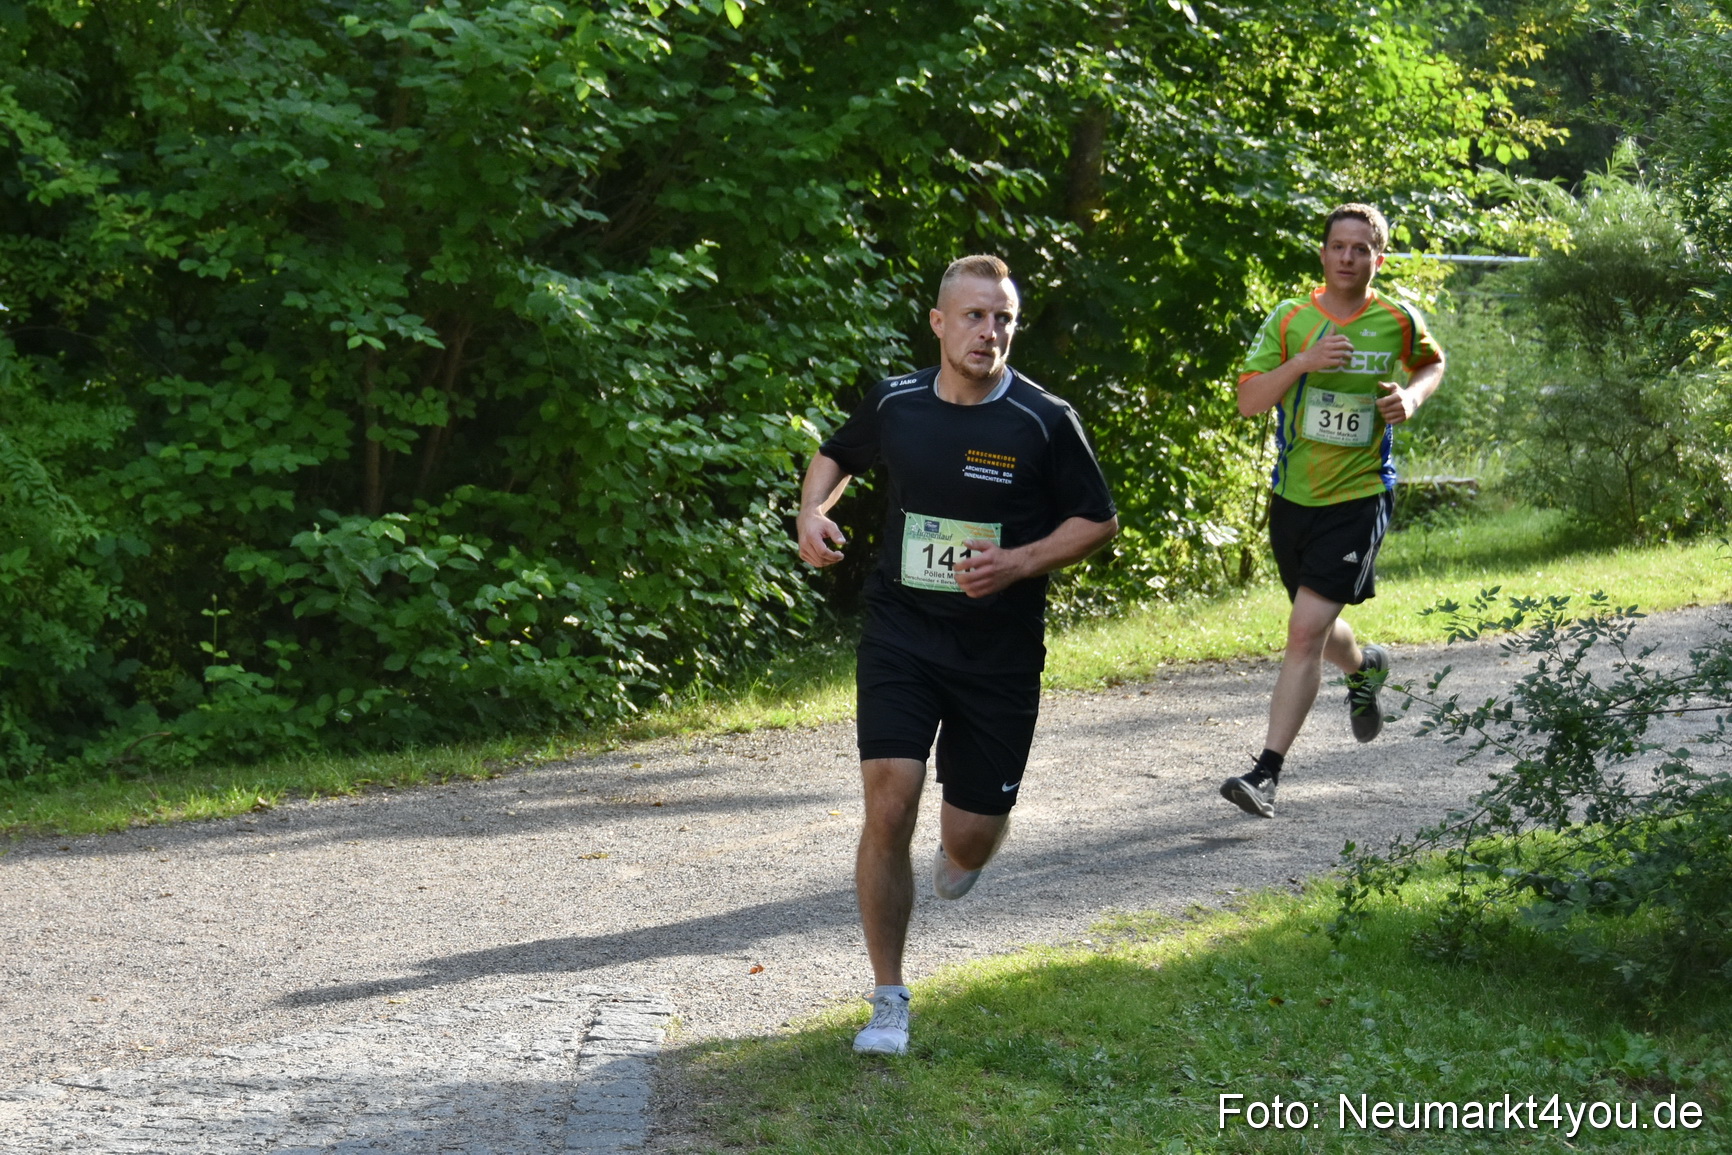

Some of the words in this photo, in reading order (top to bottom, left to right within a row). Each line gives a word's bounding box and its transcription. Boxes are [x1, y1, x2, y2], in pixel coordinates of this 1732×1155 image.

[899, 378, 917, 386] JAKO
[1318, 409, 1360, 432] 316
[968, 449, 1016, 462] BERSCHNEIDER
[967, 456, 1015, 469] BERSCHNEIDER
[965, 465, 999, 475] ARCHITEKTEN
[922, 543, 971, 572] 141
